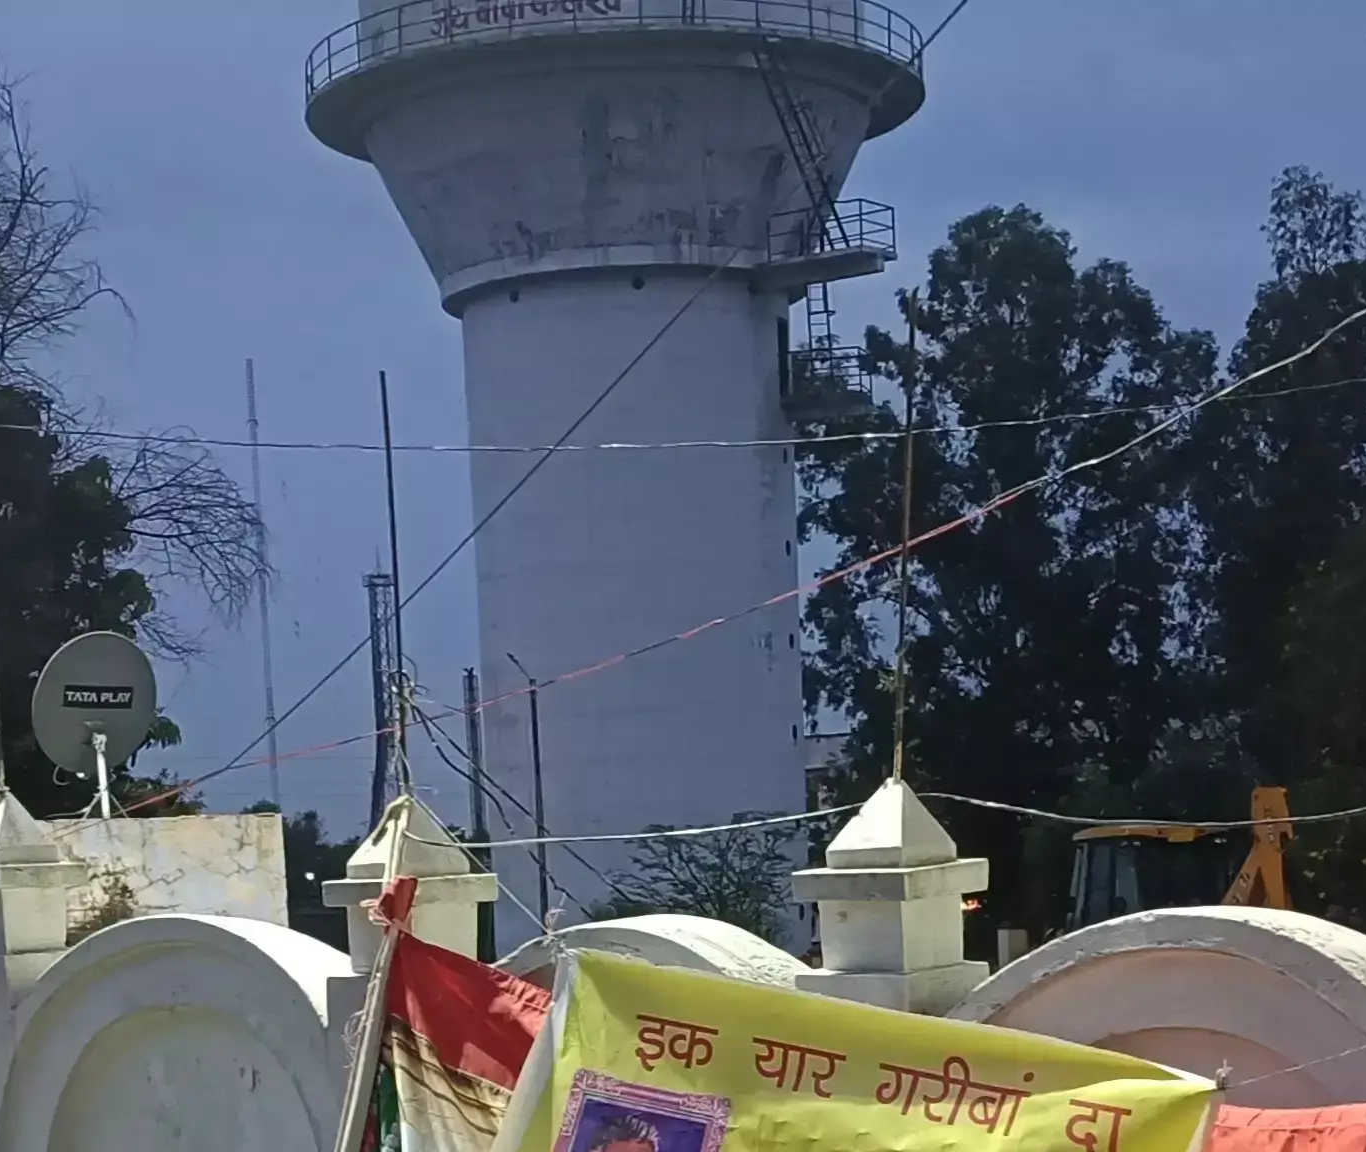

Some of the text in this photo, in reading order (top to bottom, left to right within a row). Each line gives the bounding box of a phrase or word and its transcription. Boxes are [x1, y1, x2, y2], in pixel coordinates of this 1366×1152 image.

[65, 690, 132, 703] TATA PLAY
[635, 1014, 719, 1072] इक
[752, 1036, 846, 1098] यार
[875, 1056, 1035, 1137] गरीबां
